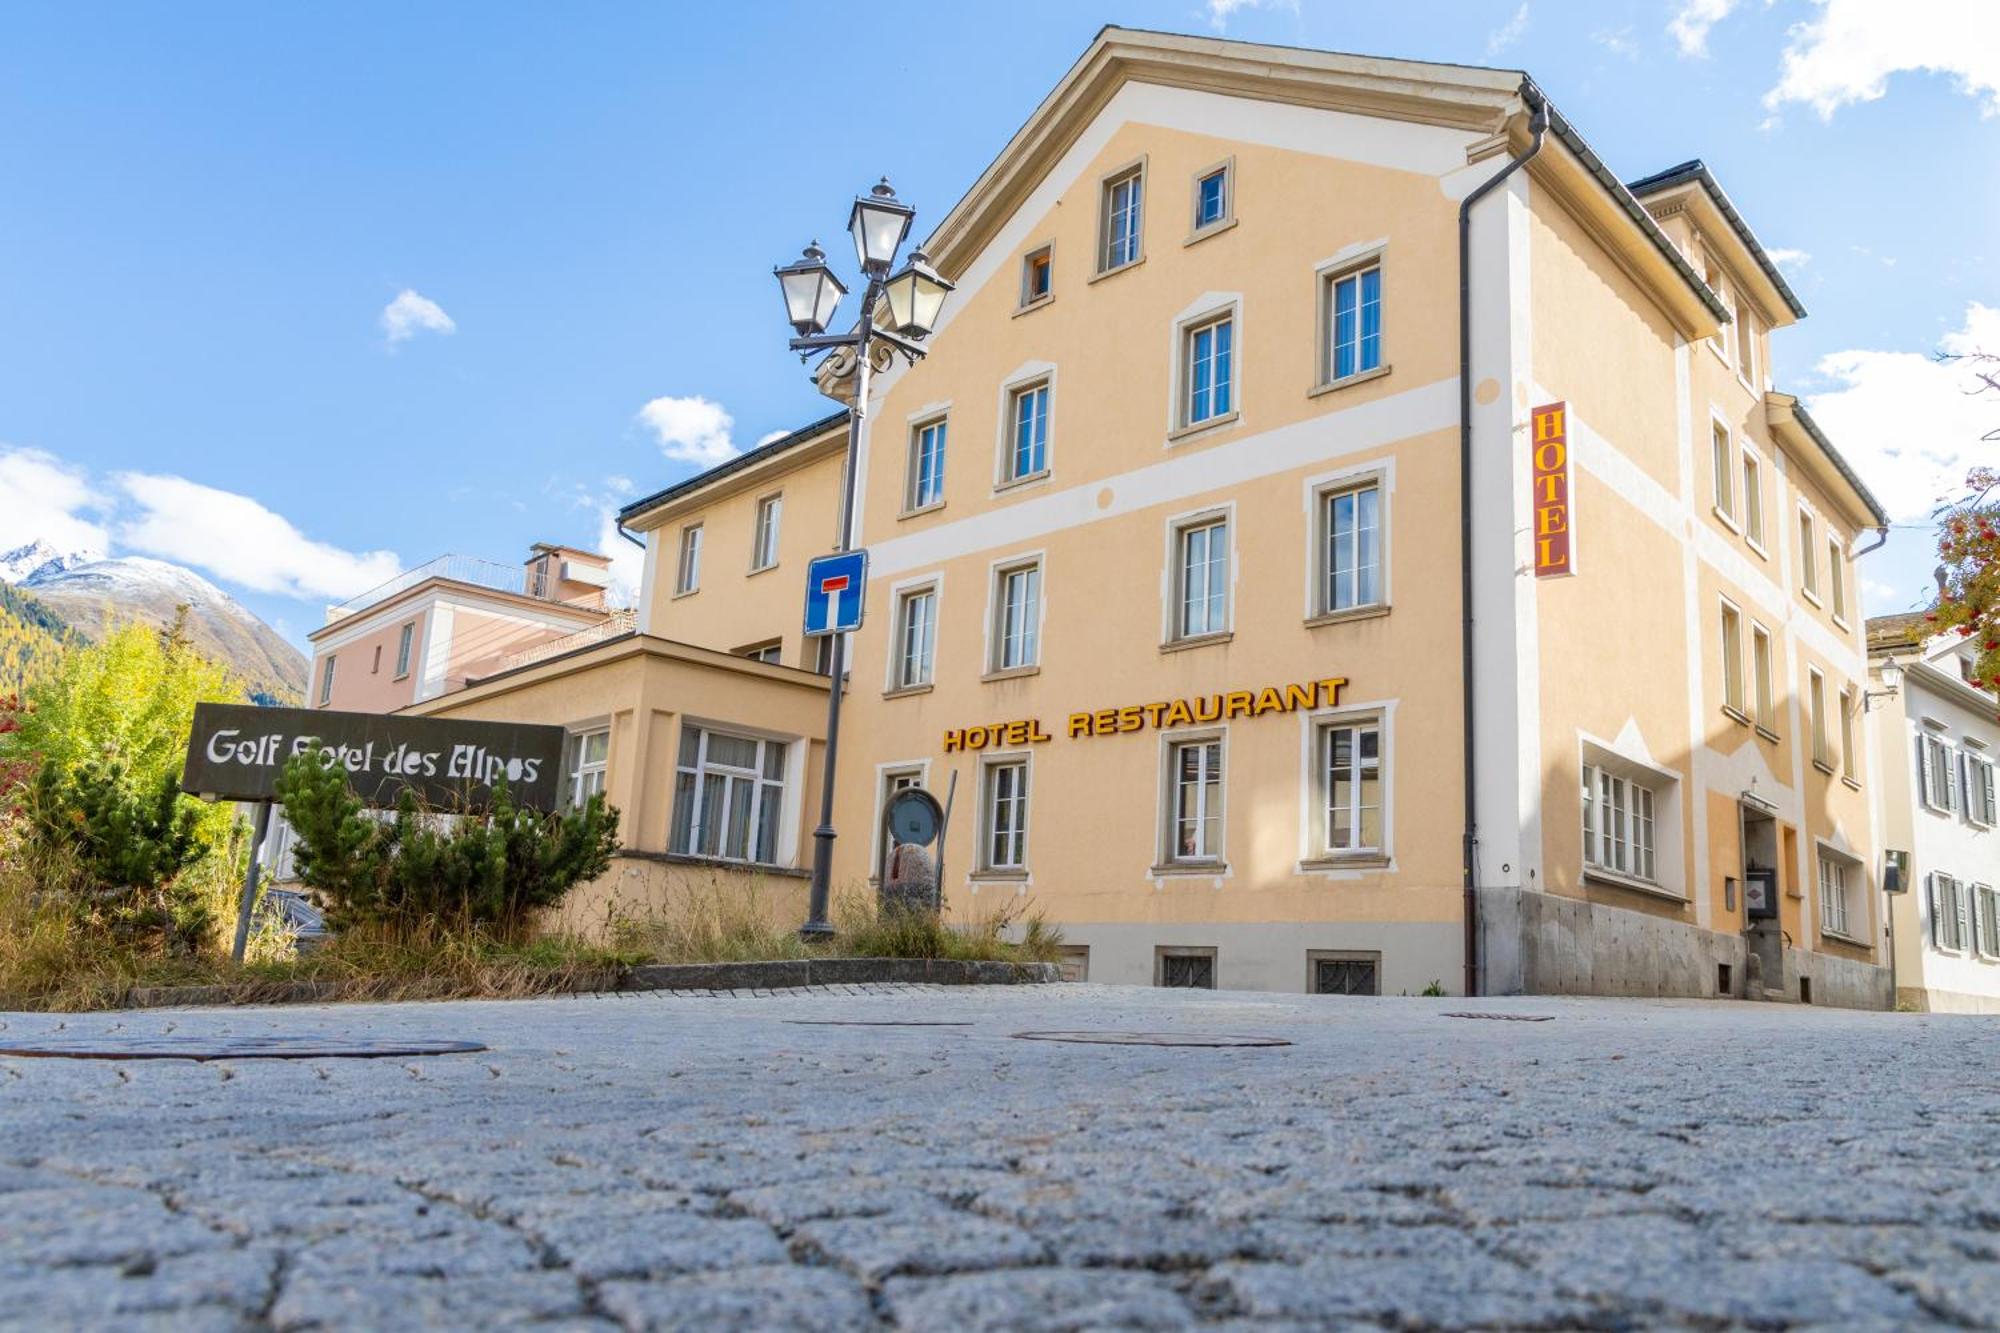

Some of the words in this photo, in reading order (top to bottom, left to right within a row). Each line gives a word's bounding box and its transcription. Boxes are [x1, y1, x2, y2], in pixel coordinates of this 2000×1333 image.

[1535, 410, 1567, 567] HOTEL
[207, 729, 283, 766] Golf
[383, 742, 441, 777] des
[943, 719, 1052, 753] HOTEL
[1068, 677, 1348, 738] RESTAURANT
